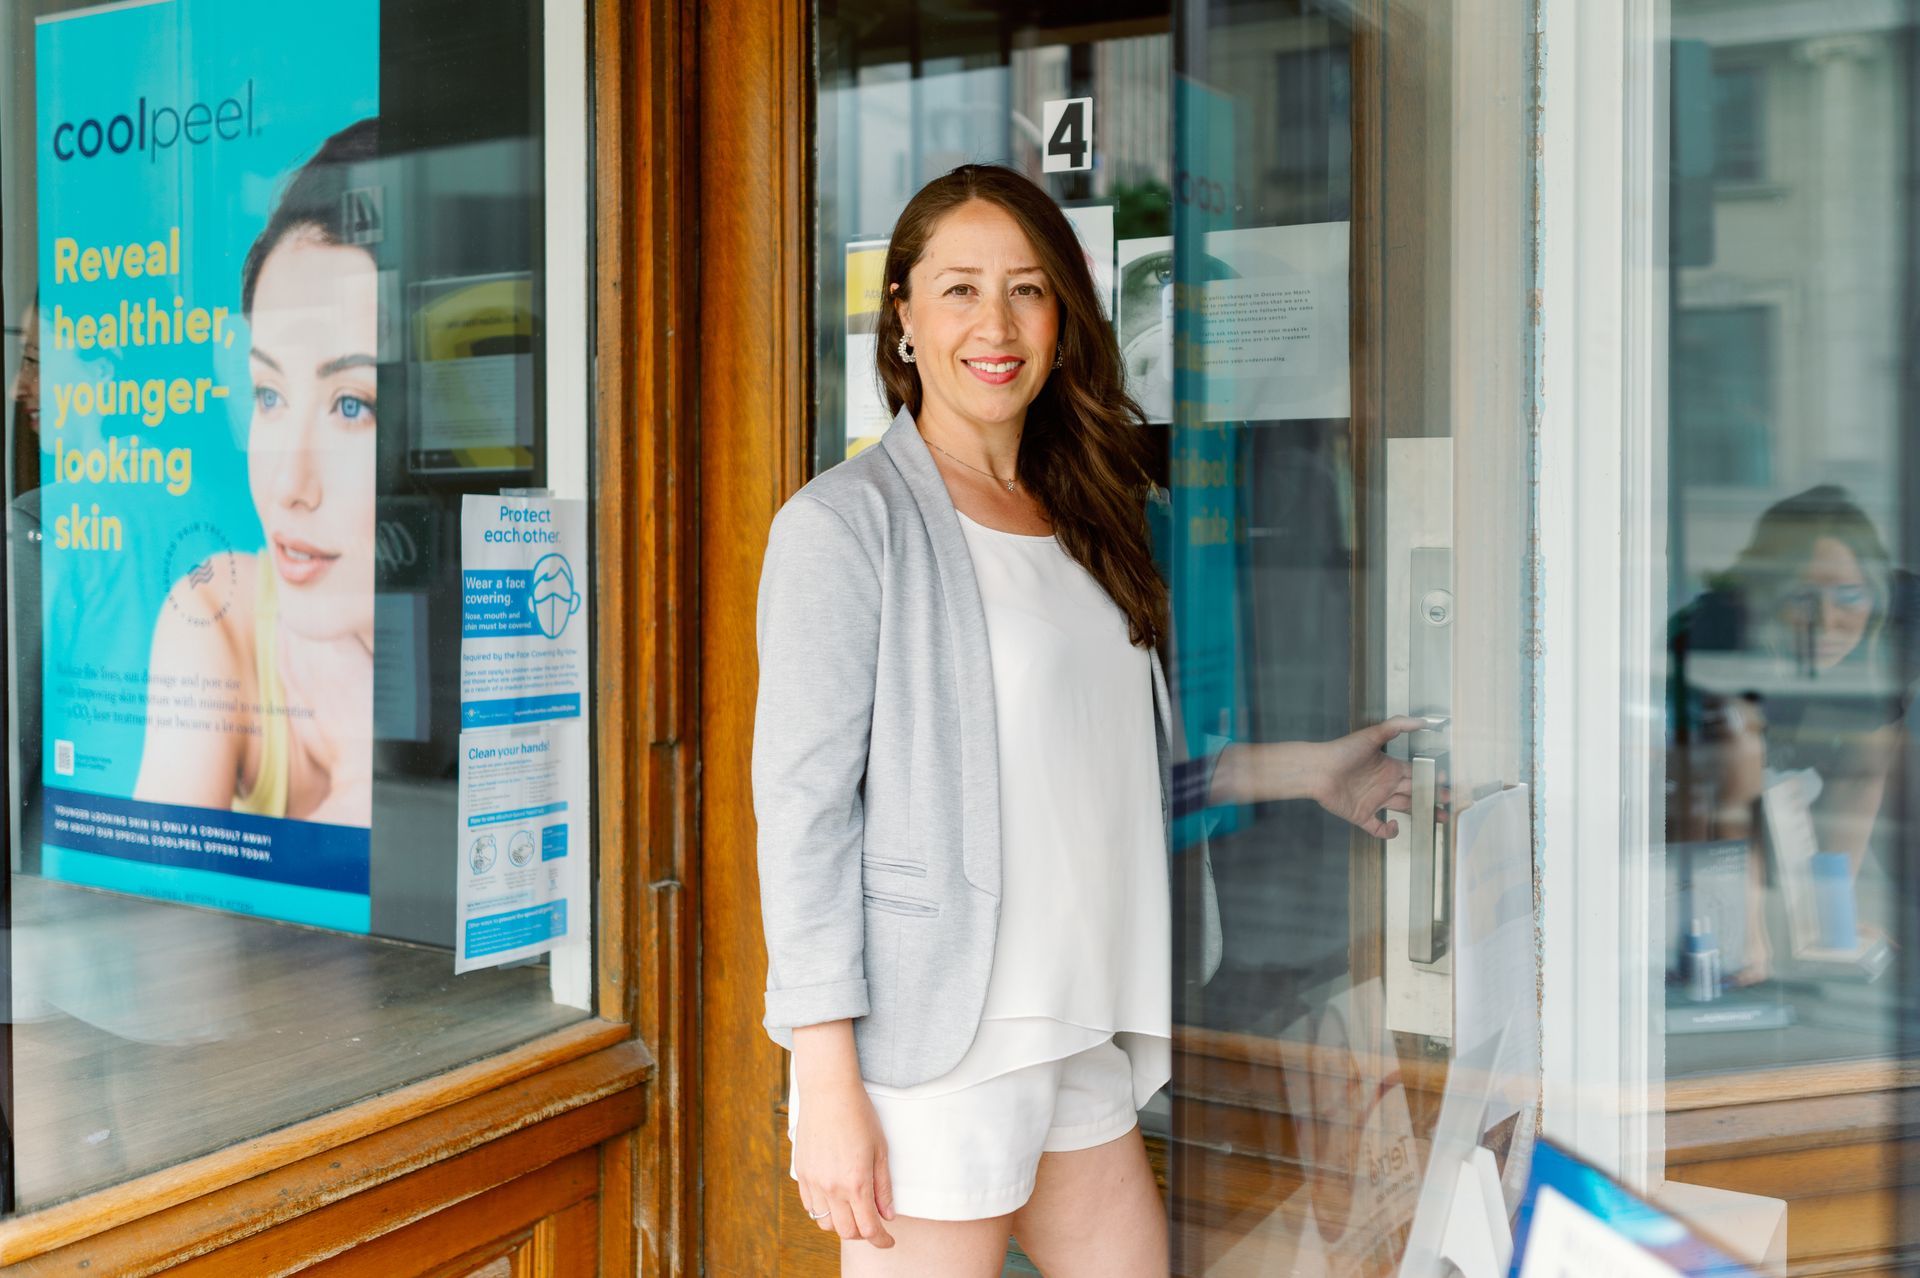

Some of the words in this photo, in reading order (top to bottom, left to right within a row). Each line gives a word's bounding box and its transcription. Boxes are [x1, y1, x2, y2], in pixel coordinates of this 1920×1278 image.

[1048, 102, 1088, 168] 4
[54, 226, 180, 284] Reveal
[54, 295, 235, 350] healthier,
[53, 377, 230, 429] younger-
[54, 434, 193, 497] looking
[54, 502, 122, 551] skin
[500, 505, 551, 523] Protect
[484, 527, 520, 543] each
[523, 527, 566, 544] other.
[465, 576, 493, 590] Wear
[496, 578, 503, 589] a
[505, 575, 526, 589] face
[465, 591, 513, 607] covering.
[465, 622, 478, 632] chin
[479, 620, 497, 631] must
[498, 619, 507, 630] be
[484, 611, 507, 620] mouth
[508, 610, 521, 619] and
[493, 651, 503, 661] by
[504, 650, 516, 660] the
[468, 747, 495, 760] Clean
[497, 746, 519, 758] your
[54, 804, 90, 821] YOUNGER
[91, 811, 127, 827] LOOKING
[128, 816, 149, 830] SKIN
[150, 819, 160, 832] IS
[161, 821, 188, 835] ONLY
[190, 824, 198, 836] A
[199, 825, 241, 841] CONSULT
[242, 831, 272, 847] AWAY!
[54, 818, 69, 831] ASK
[70, 821, 95, 837] ABOUT
[96, 826, 114, 839] OUR
[115, 829, 150, 845] SPECIAL
[151, 834, 202, 852] COOLPEEL
[203, 841, 239, 857] OFFERS
